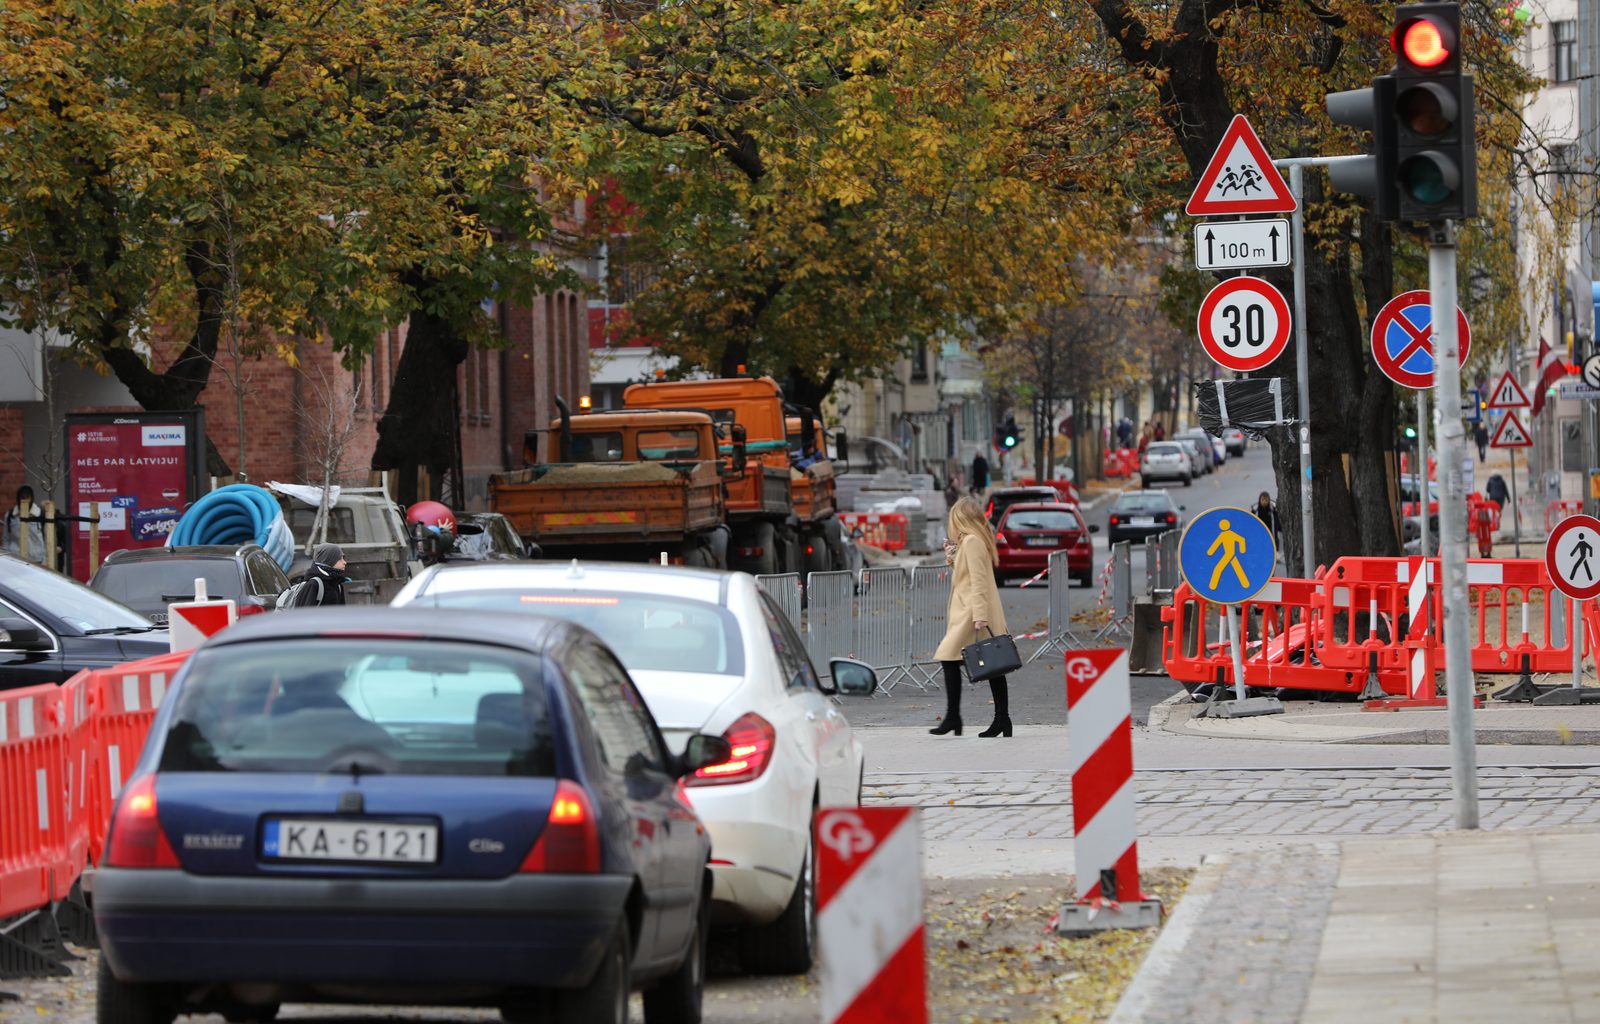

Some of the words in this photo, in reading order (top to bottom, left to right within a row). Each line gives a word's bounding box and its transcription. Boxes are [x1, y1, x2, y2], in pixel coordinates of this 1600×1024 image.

[1220, 242, 1249, 259] 100
[1253, 247, 1265, 257] m
[1222, 304, 1264, 347] 30
[130, 457, 178, 465] LATVIJU!
[140, 518, 176, 534] Selga
[287, 827, 428, 858] KA-6121
